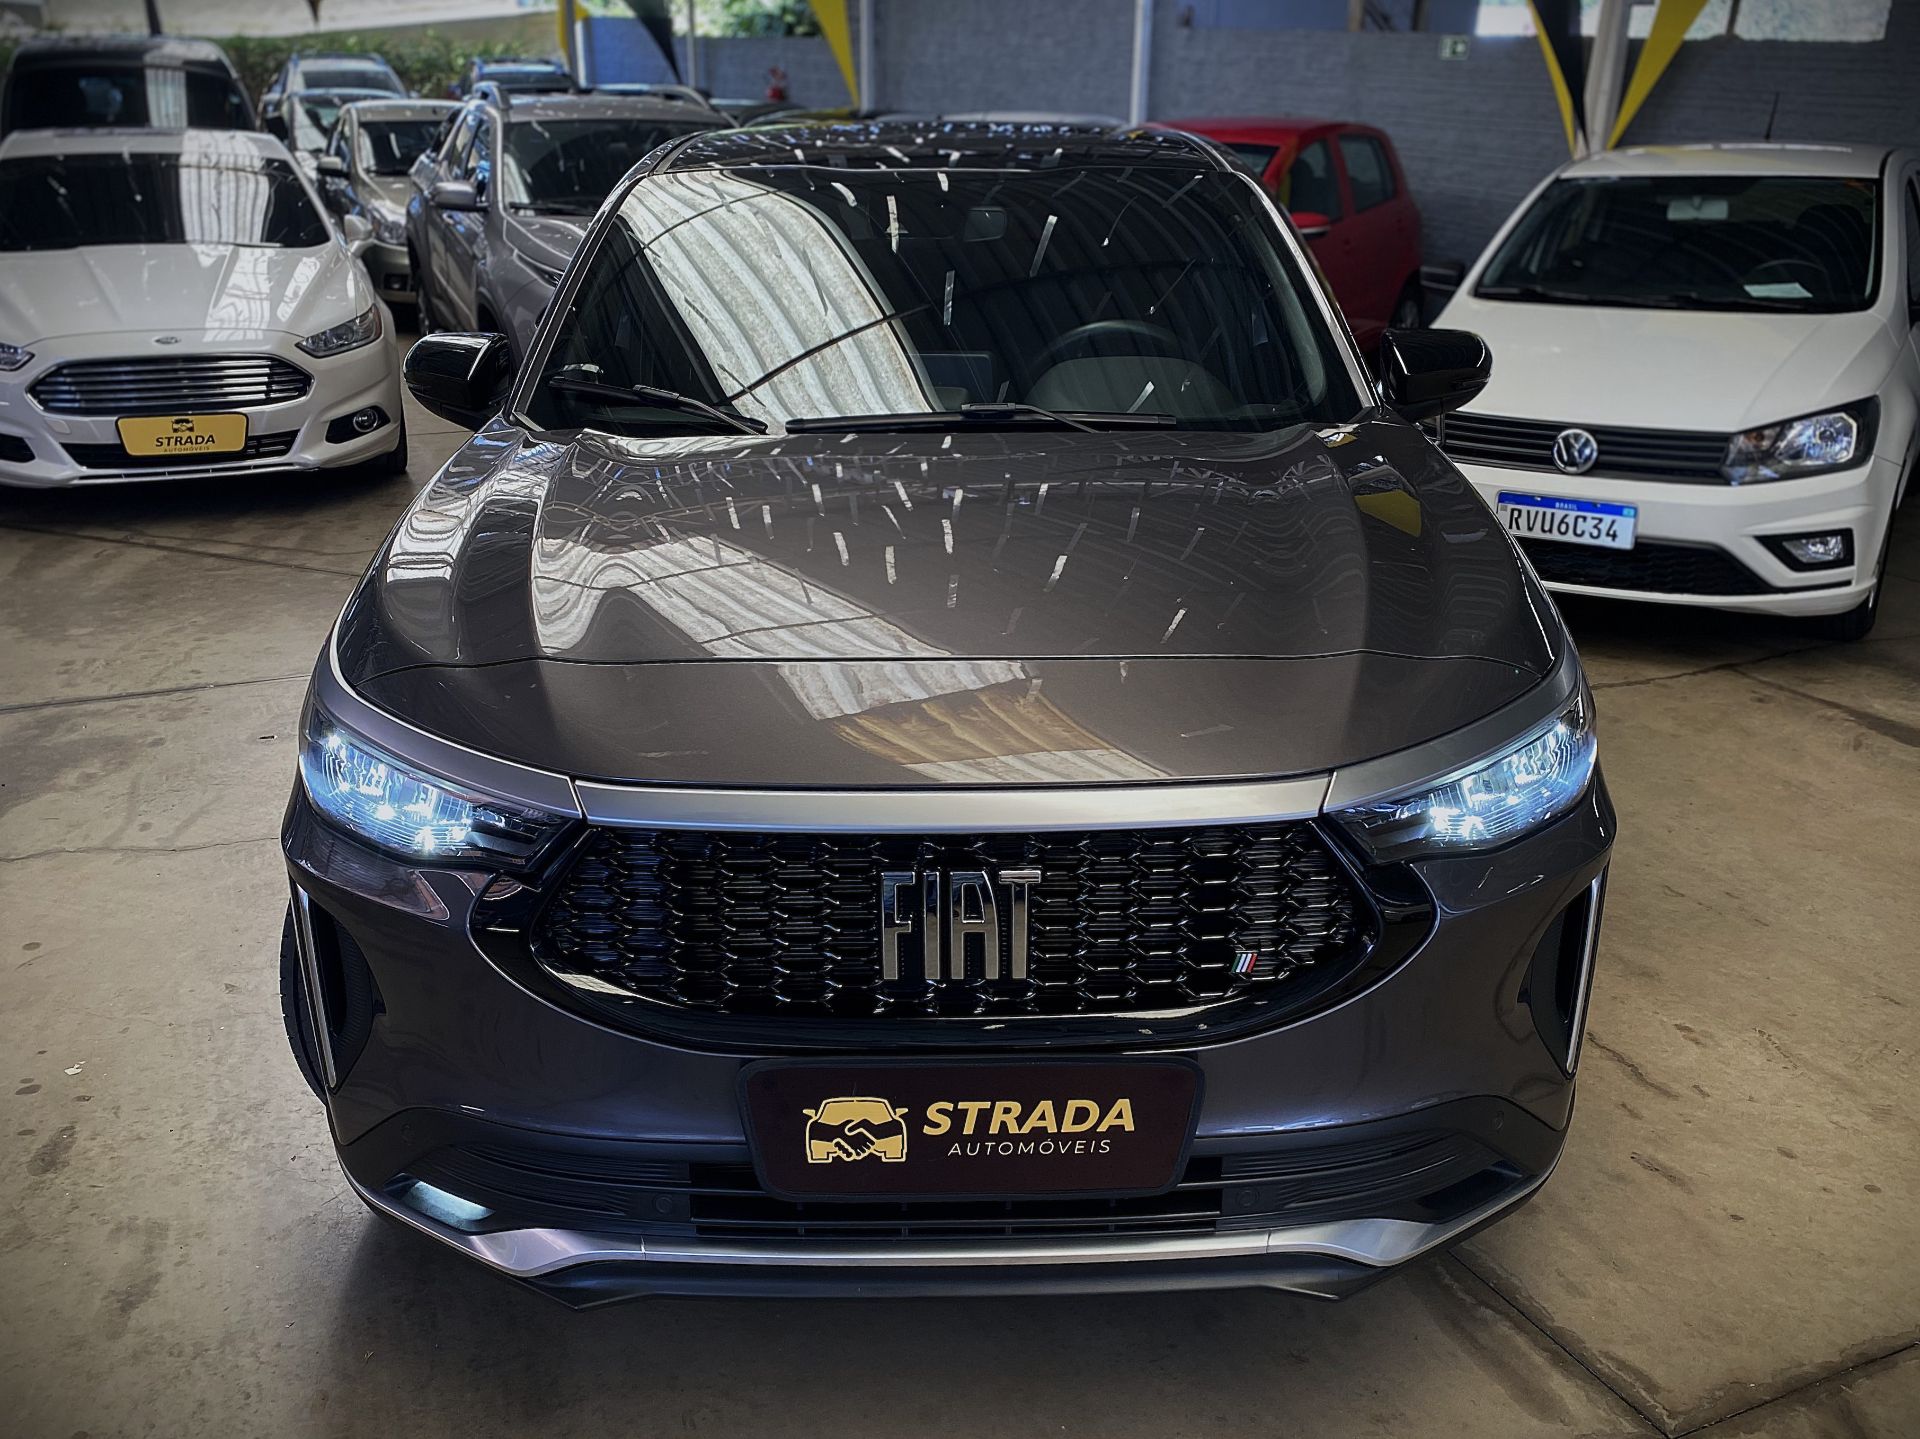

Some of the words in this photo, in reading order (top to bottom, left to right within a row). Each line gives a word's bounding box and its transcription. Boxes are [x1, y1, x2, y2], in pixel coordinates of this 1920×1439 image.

[155, 434, 216, 447] STRADA
[1555, 501, 1578, 511] BRASIL
[1508, 507, 1618, 542] RVU6C34
[881, 869, 1042, 980] FIAT
[922, 1098, 1136, 1136] STRADA
[948, 1138, 1112, 1157] AUTOMÓVEIS
